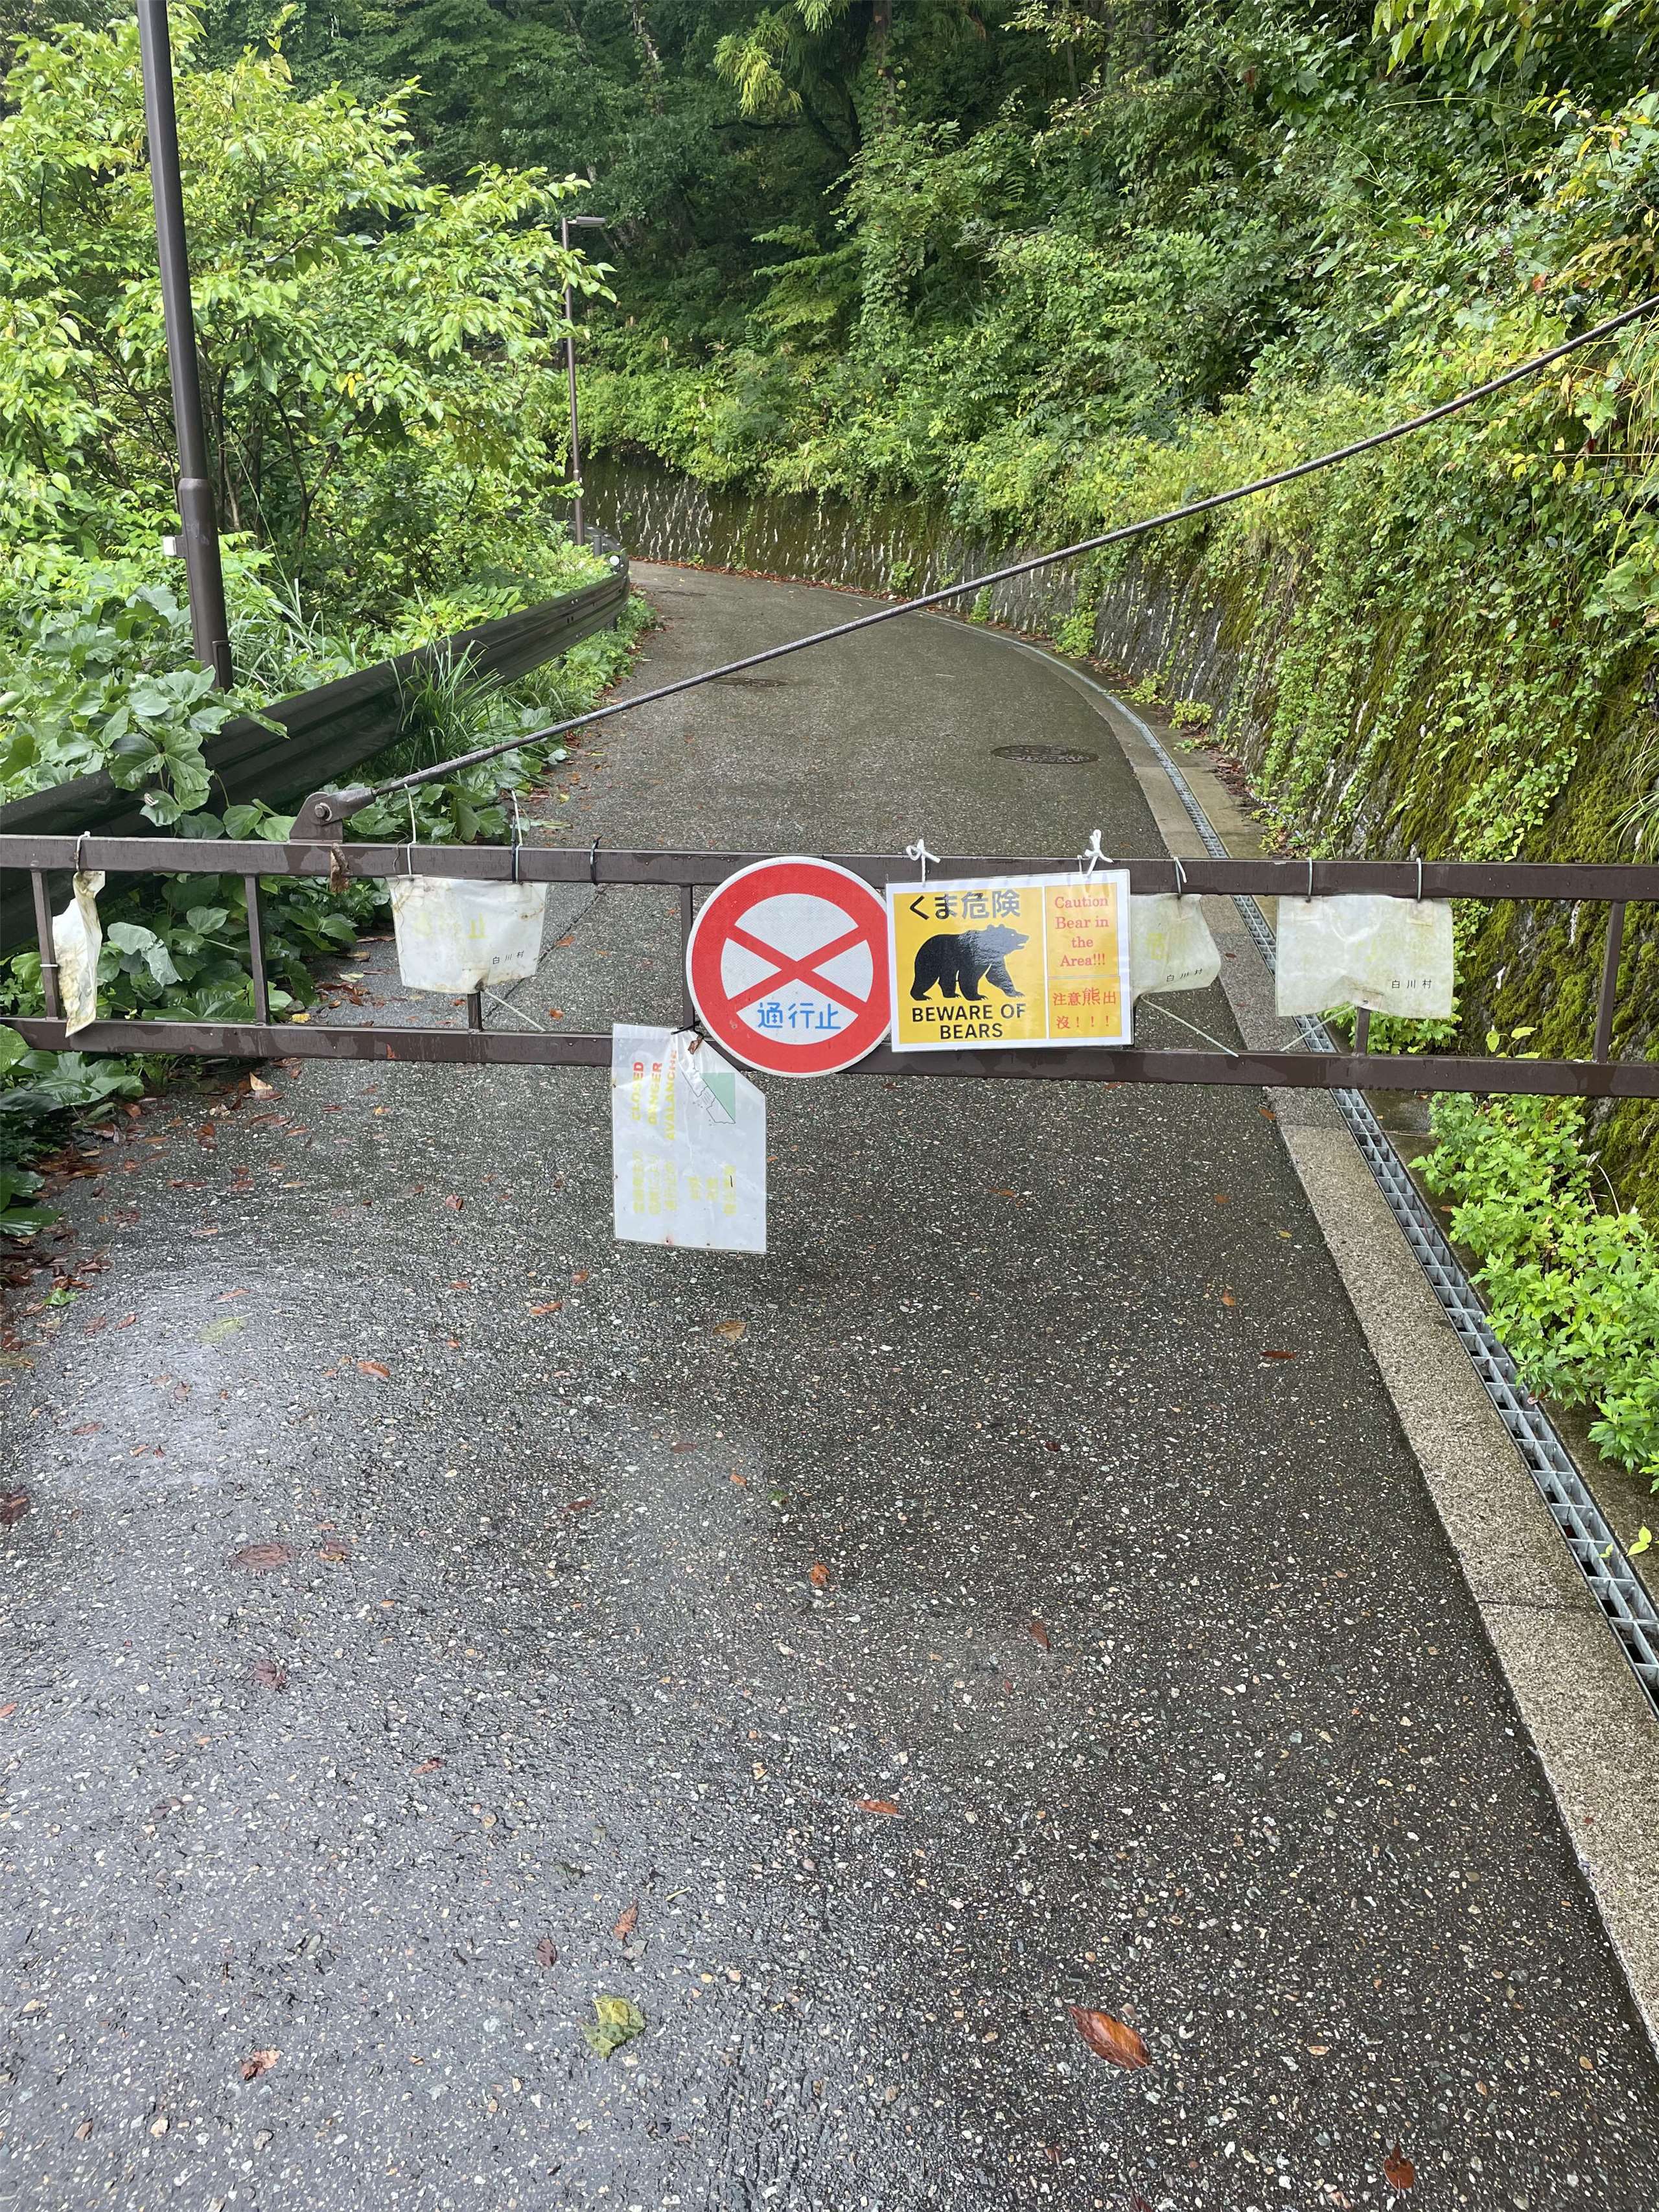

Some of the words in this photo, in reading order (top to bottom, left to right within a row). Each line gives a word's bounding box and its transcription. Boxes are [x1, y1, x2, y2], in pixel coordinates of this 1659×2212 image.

[909, 889, 1021, 921] くま危険
[1054, 896, 1109, 909] Caution
[1055, 916, 1091, 929] Bear
[1095, 915, 1109, 928] in
[1072, 937, 1094, 948] the
[493, 950, 524, 964] 白川村
[1060, 953, 1106, 968] Area!!!
[1391, 979, 1432, 989] 白川村
[1052, 987, 1117, 1007] 注意熊出
[756, 1002, 842, 1030] 通行止
[912, 1005, 993, 1022] BEWARE
[1000, 1003, 1027, 1019] OF
[940, 1023, 1003, 1040] BEARS
